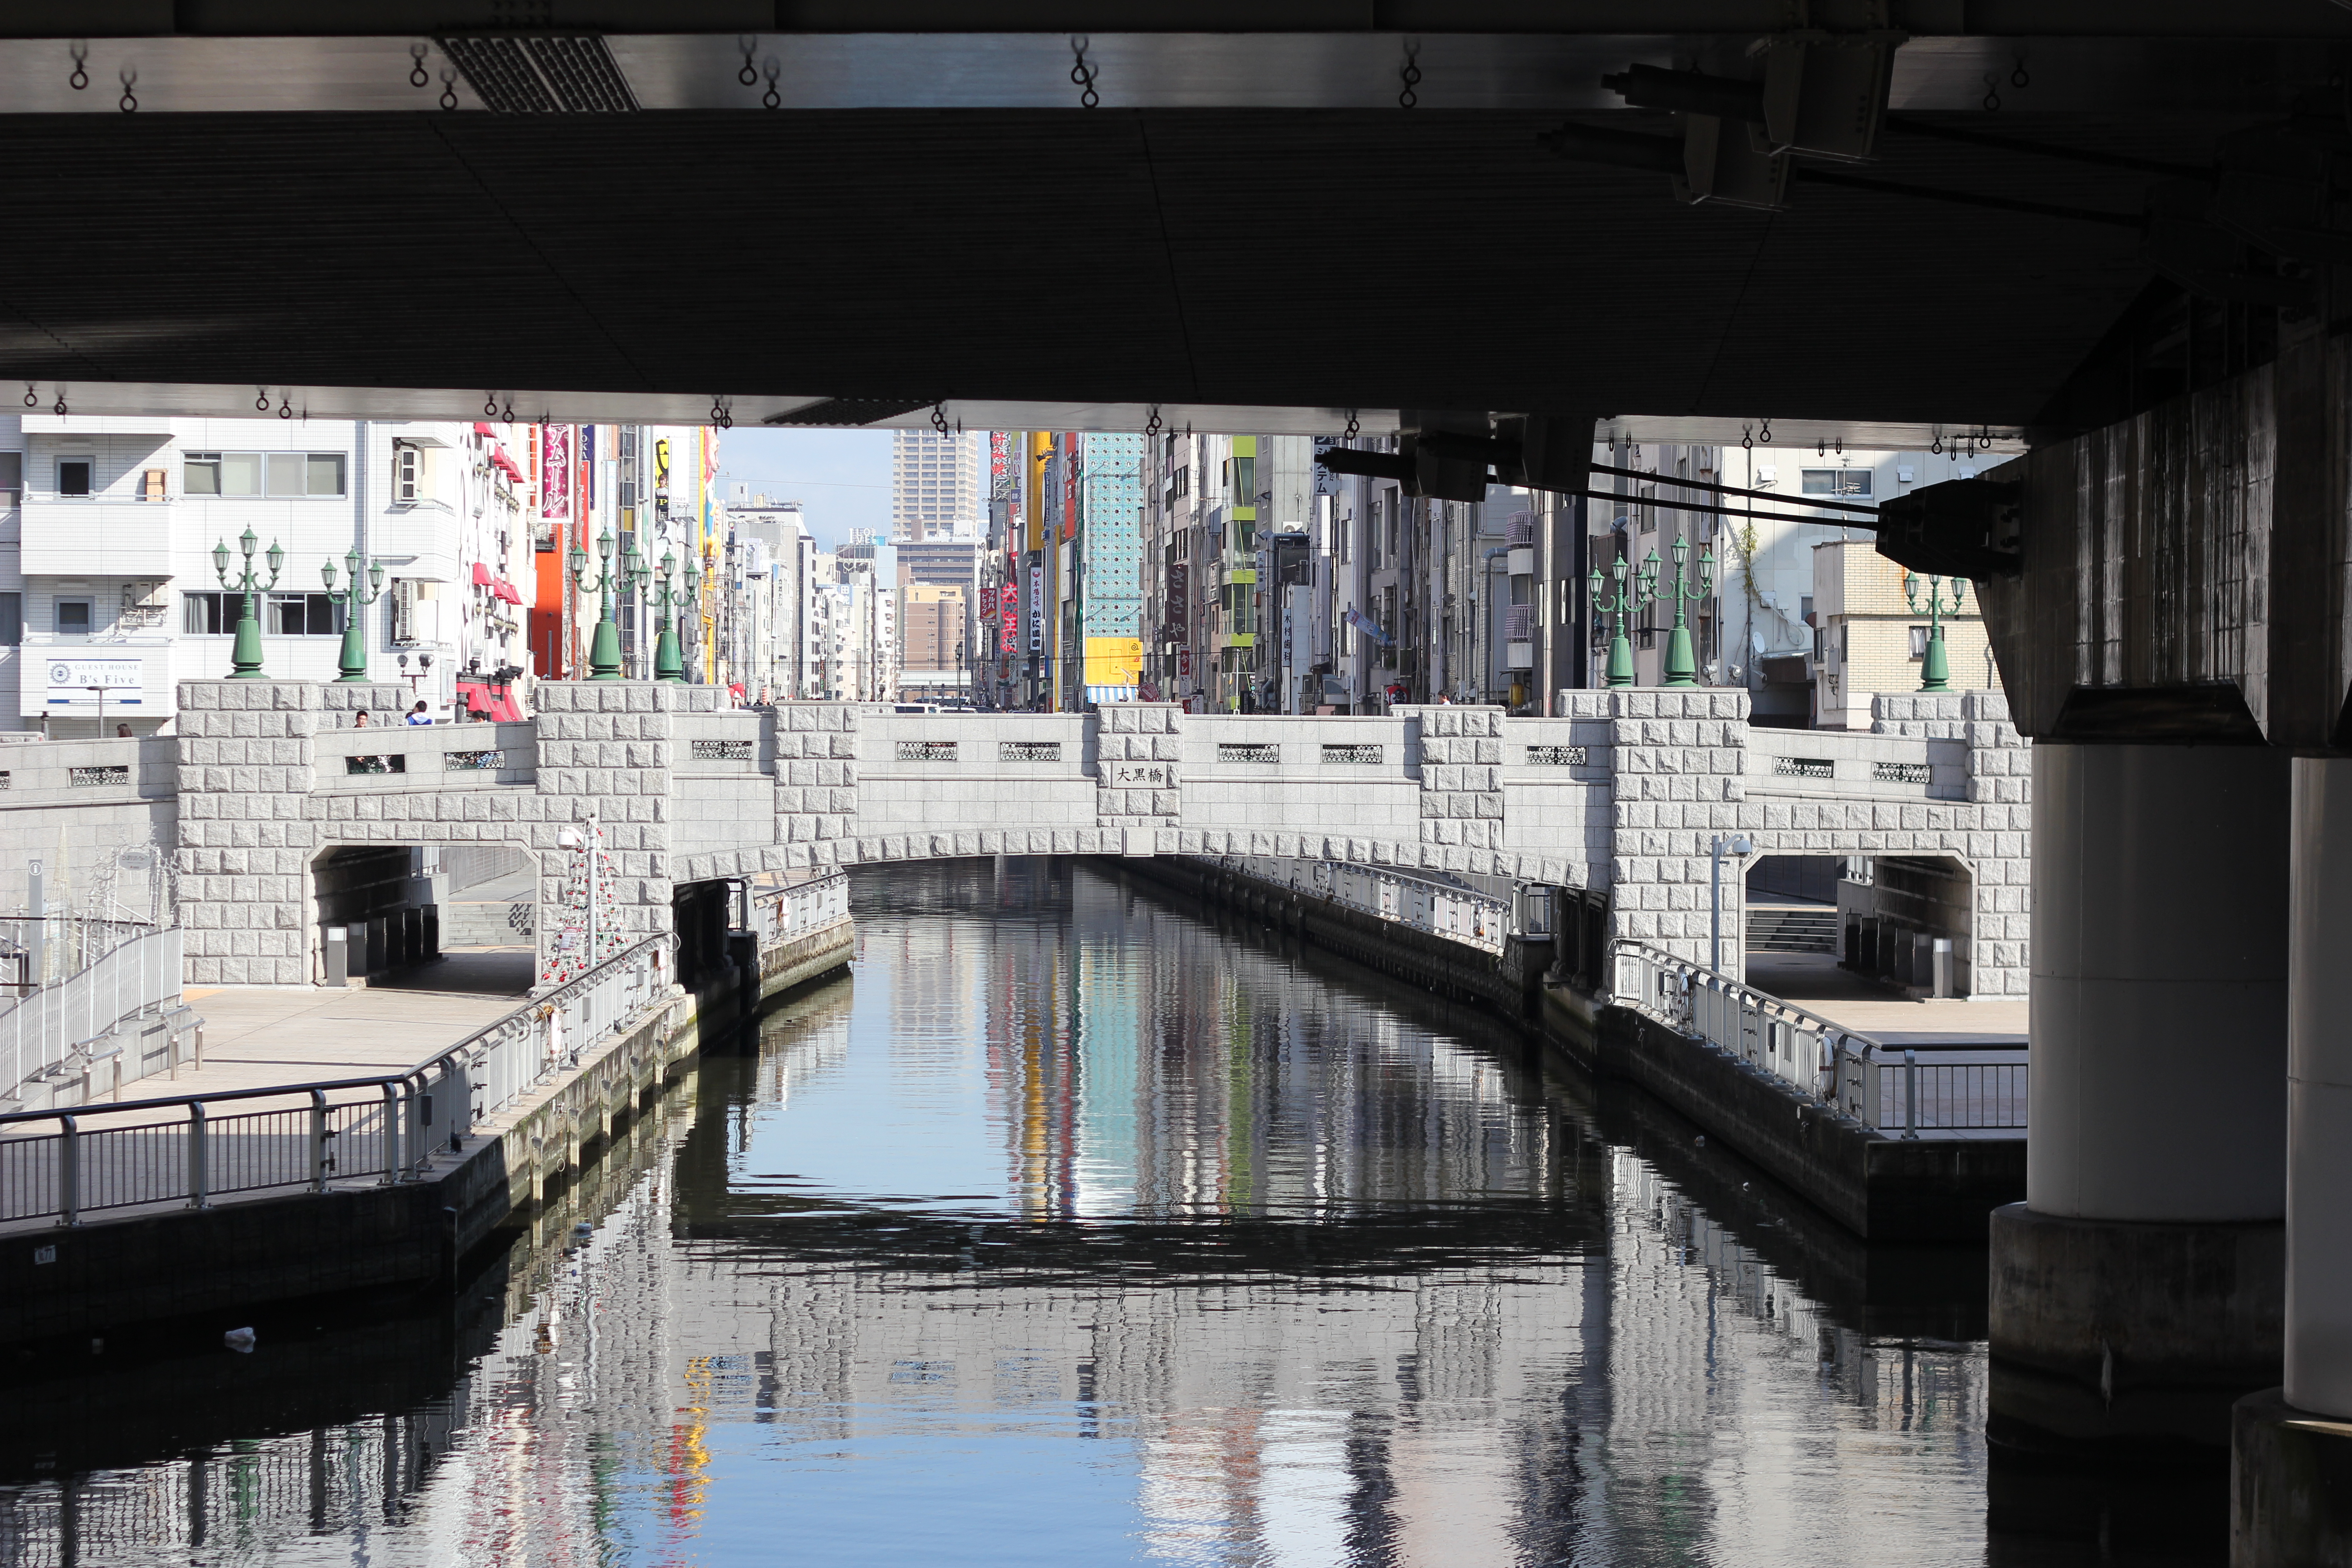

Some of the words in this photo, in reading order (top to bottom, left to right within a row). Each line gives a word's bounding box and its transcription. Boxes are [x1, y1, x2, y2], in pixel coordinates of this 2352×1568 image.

[1170, 569, 1186, 638] ささや
[79, 675, 98, 684] B's
[104, 675, 135, 684] Five
[1392, 688, 1406, 704] 魚
[1117, 767, 1163, 783] 大黒橋
